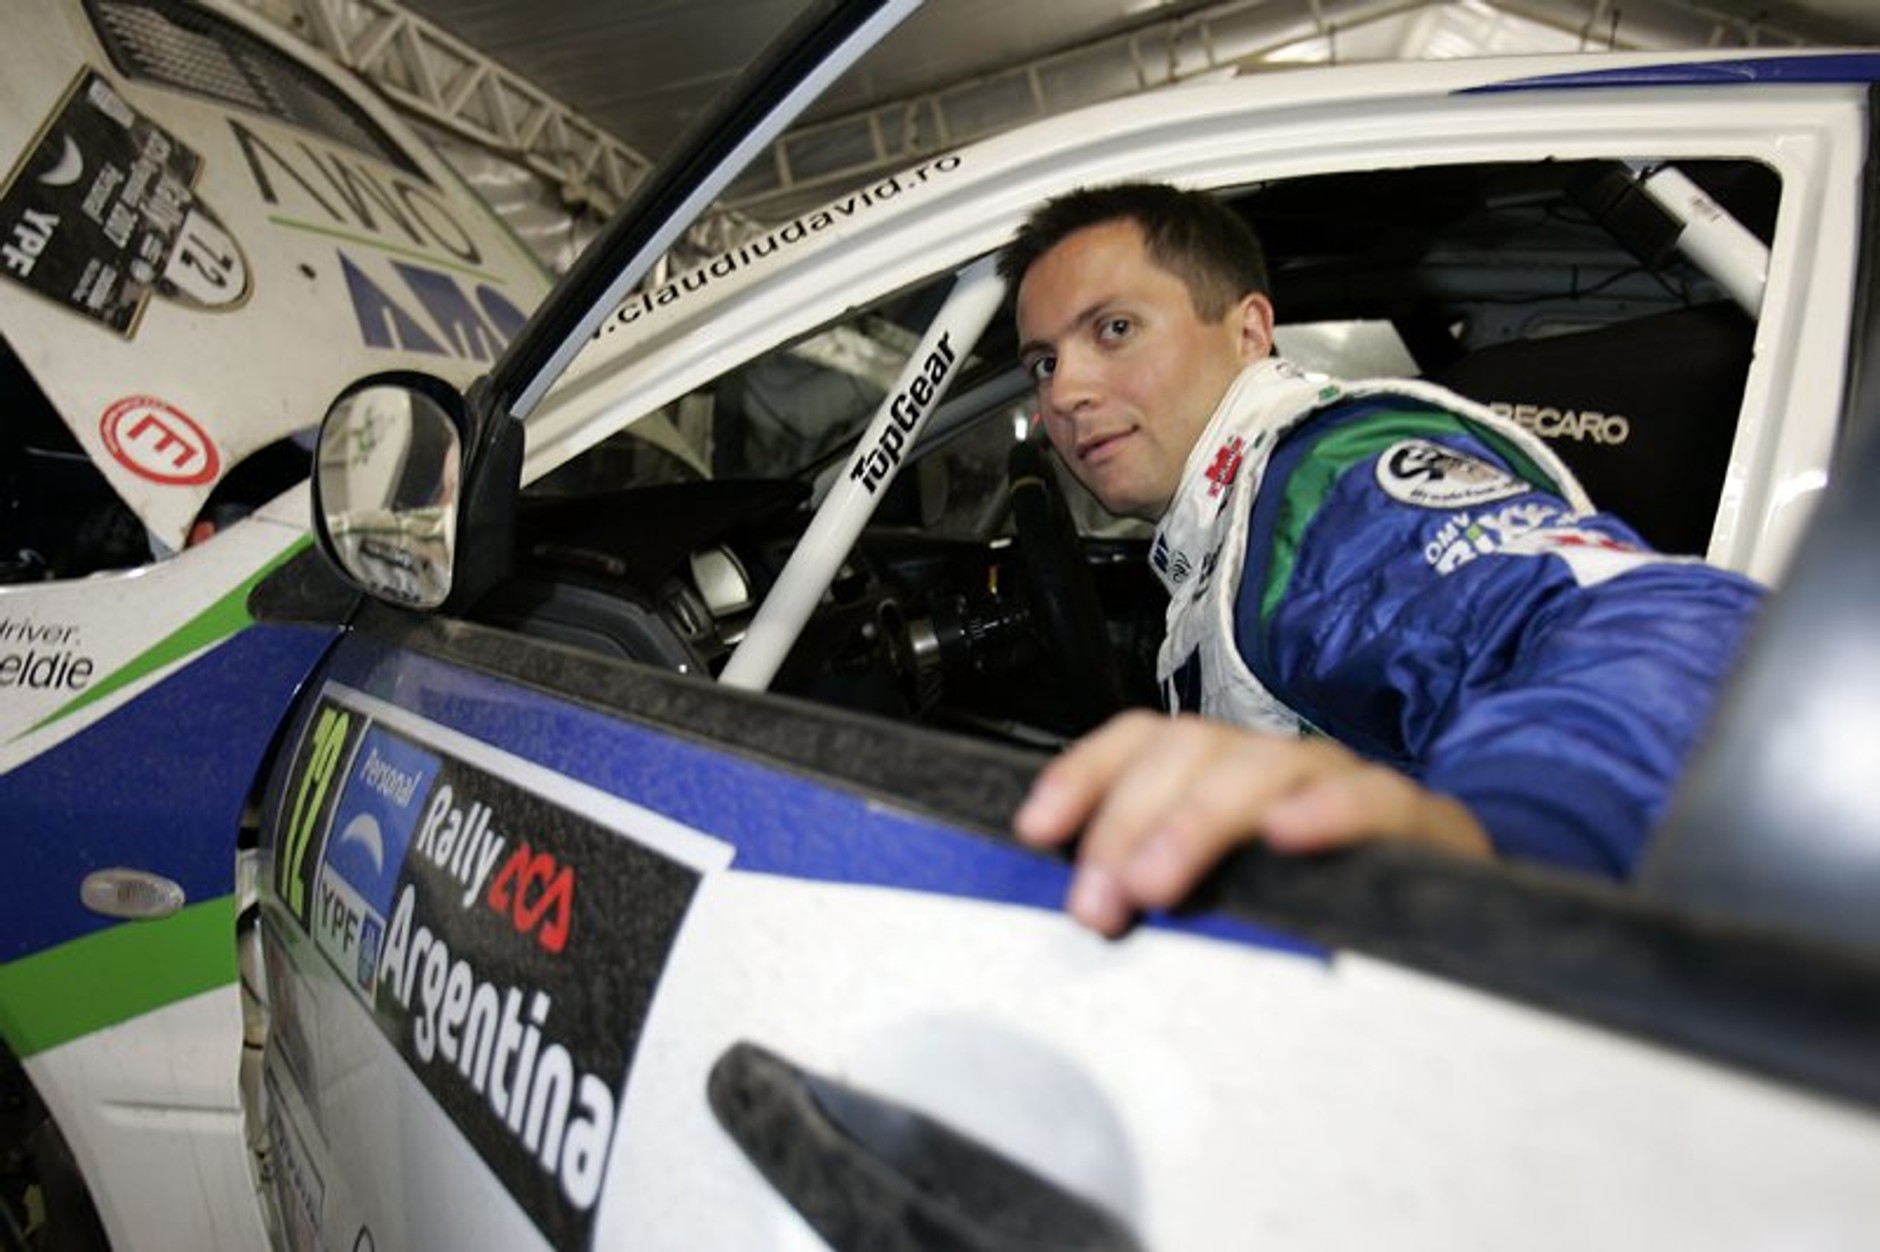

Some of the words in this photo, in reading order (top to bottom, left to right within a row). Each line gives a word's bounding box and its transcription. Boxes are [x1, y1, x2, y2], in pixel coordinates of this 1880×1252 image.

[1, 208, 60, 278] YPF
[126, 412, 197, 469] E
[850, 330, 956, 495] TopGear
[358, 747, 423, 808] Personal
[417, 783, 506, 909] Rally
[319, 880, 360, 953] YPF
[379, 882, 615, 1212] Argentina
